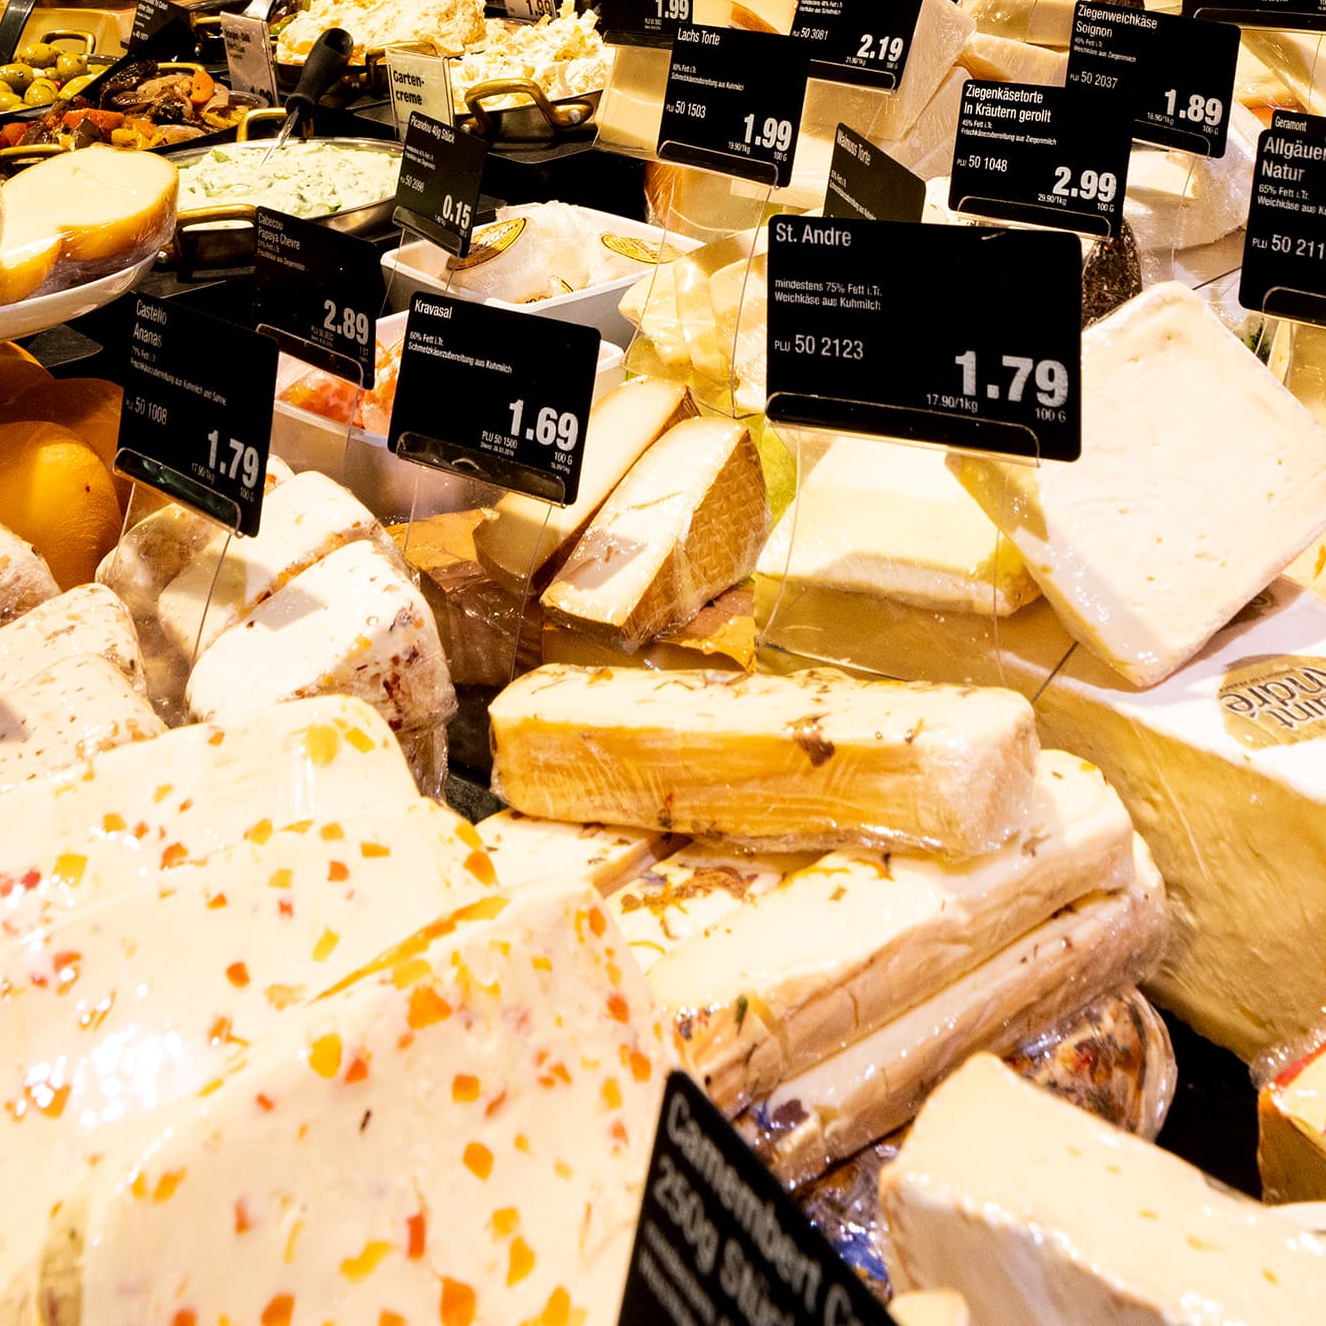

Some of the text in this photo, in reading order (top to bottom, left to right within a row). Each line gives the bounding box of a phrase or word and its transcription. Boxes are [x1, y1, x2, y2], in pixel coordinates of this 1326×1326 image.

[1078, 4, 1158, 30] Ziegenweichkäse
[677, 27, 720, 45] Lachs Torte
[1076, 21, 1113, 38] Soignon
[857, 34, 904, 62] 2.19
[393, 70, 425, 88] Garten-
[1081, 71, 1093, 84] 50
[1094, 74, 1118, 89] 2037
[395, 90, 422, 106] creme
[966, 84, 1043, 104] Ziegenkäsetorte
[675, 100, 685, 114] 50
[687, 103, 706, 118] 1503
[975, 102, 1016, 120] Kräutern
[1019, 109, 1051, 123] gerollt
[1164, 89, 1223, 126] 1.89
[744, 114, 792, 152] 1.99
[1275, 115, 1307, 132] Geramont
[969, 155, 981, 169] 50
[984, 157, 1007, 172] 1048
[1261, 160, 1305, 182] Natur
[1052, 166, 1117, 203] 2.99
[442, 194, 471, 230] 0.15
[1257, 195, 1300, 211] Weichkäse
[1301, 203, 1316, 214] aus
[258, 227, 279, 243] Papaya
[775, 224, 852, 247] St. Andre
[1252, 237, 1268, 249] PLU
[1271, 235, 1292, 254] 50
[775, 279, 824, 292] mindestens
[825, 282, 846, 294] 75%
[847, 284, 865, 295] Fett
[136, 298, 167, 325] Castello
[414, 298, 452, 320] Kravasal
[775, 292, 881, 311] Weichkäse aus Kuhmilch
[324, 299, 369, 345] 2.89
[134, 322, 163, 348] Ananas
[775, 334, 864, 360] PLU 50 2123
[955, 350, 1069, 408] 1.79
[135, 395, 168, 425] 50 1008
[926, 393, 978, 412] 17.90/1kg
[509, 398, 579, 452] 1.69
[207, 429, 260, 489] 1.79
